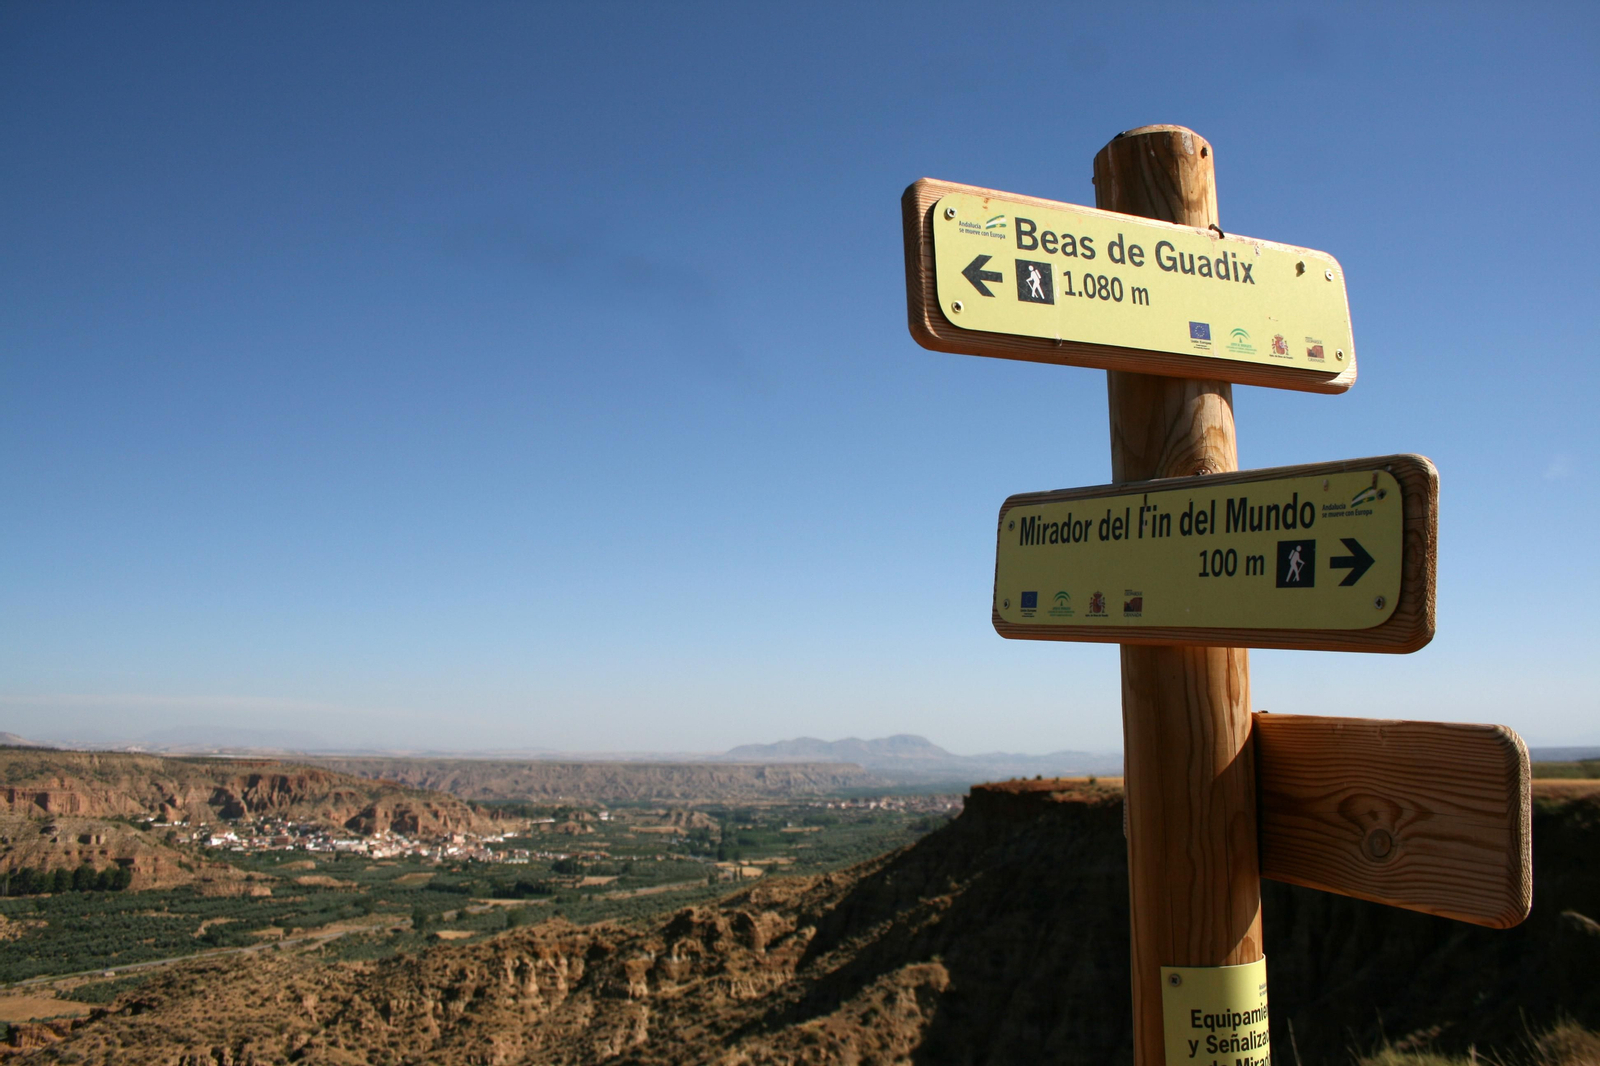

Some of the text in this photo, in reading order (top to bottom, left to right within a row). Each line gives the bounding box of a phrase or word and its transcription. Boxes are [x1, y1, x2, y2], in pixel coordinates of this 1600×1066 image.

[990, 231, 1006, 240] Europa
[1014, 217, 1256, 285] Beas de Guadix
[1063, 270, 1150, 306] 1.080 m
[1019, 492, 1316, 546] Mirador del Fin del Mundo
[1198, 548, 1265, 577] 100 m
[1188, 1039, 1199, 1059] y
